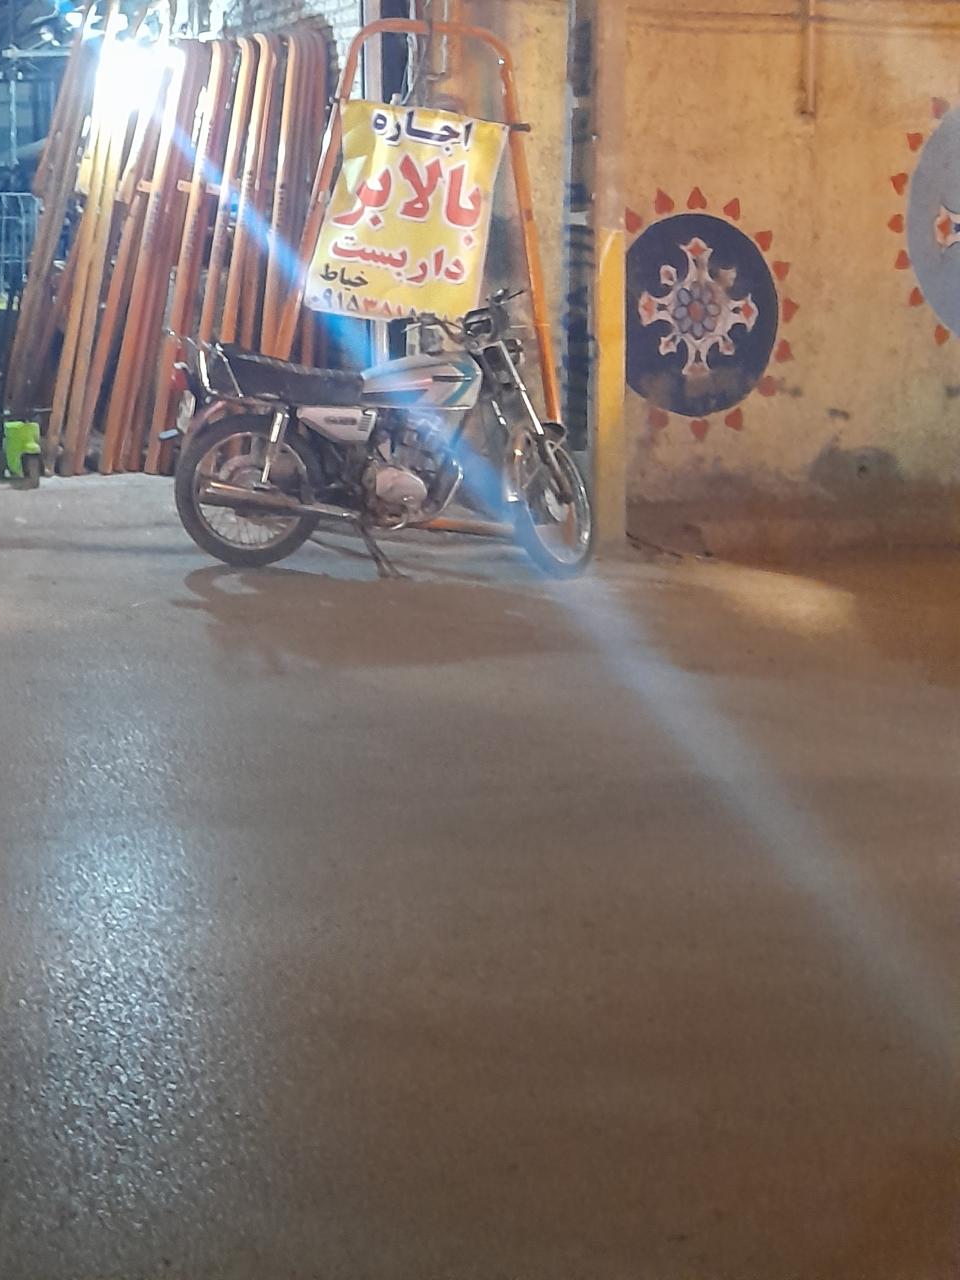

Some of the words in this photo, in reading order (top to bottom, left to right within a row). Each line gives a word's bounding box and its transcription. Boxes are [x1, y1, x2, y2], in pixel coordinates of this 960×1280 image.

[373, 110, 473, 153] اجاره
[332, 153, 482, 246] بالابر
[320, 263, 369, 292] خیاط
[331, 235, 466, 284] داربست
